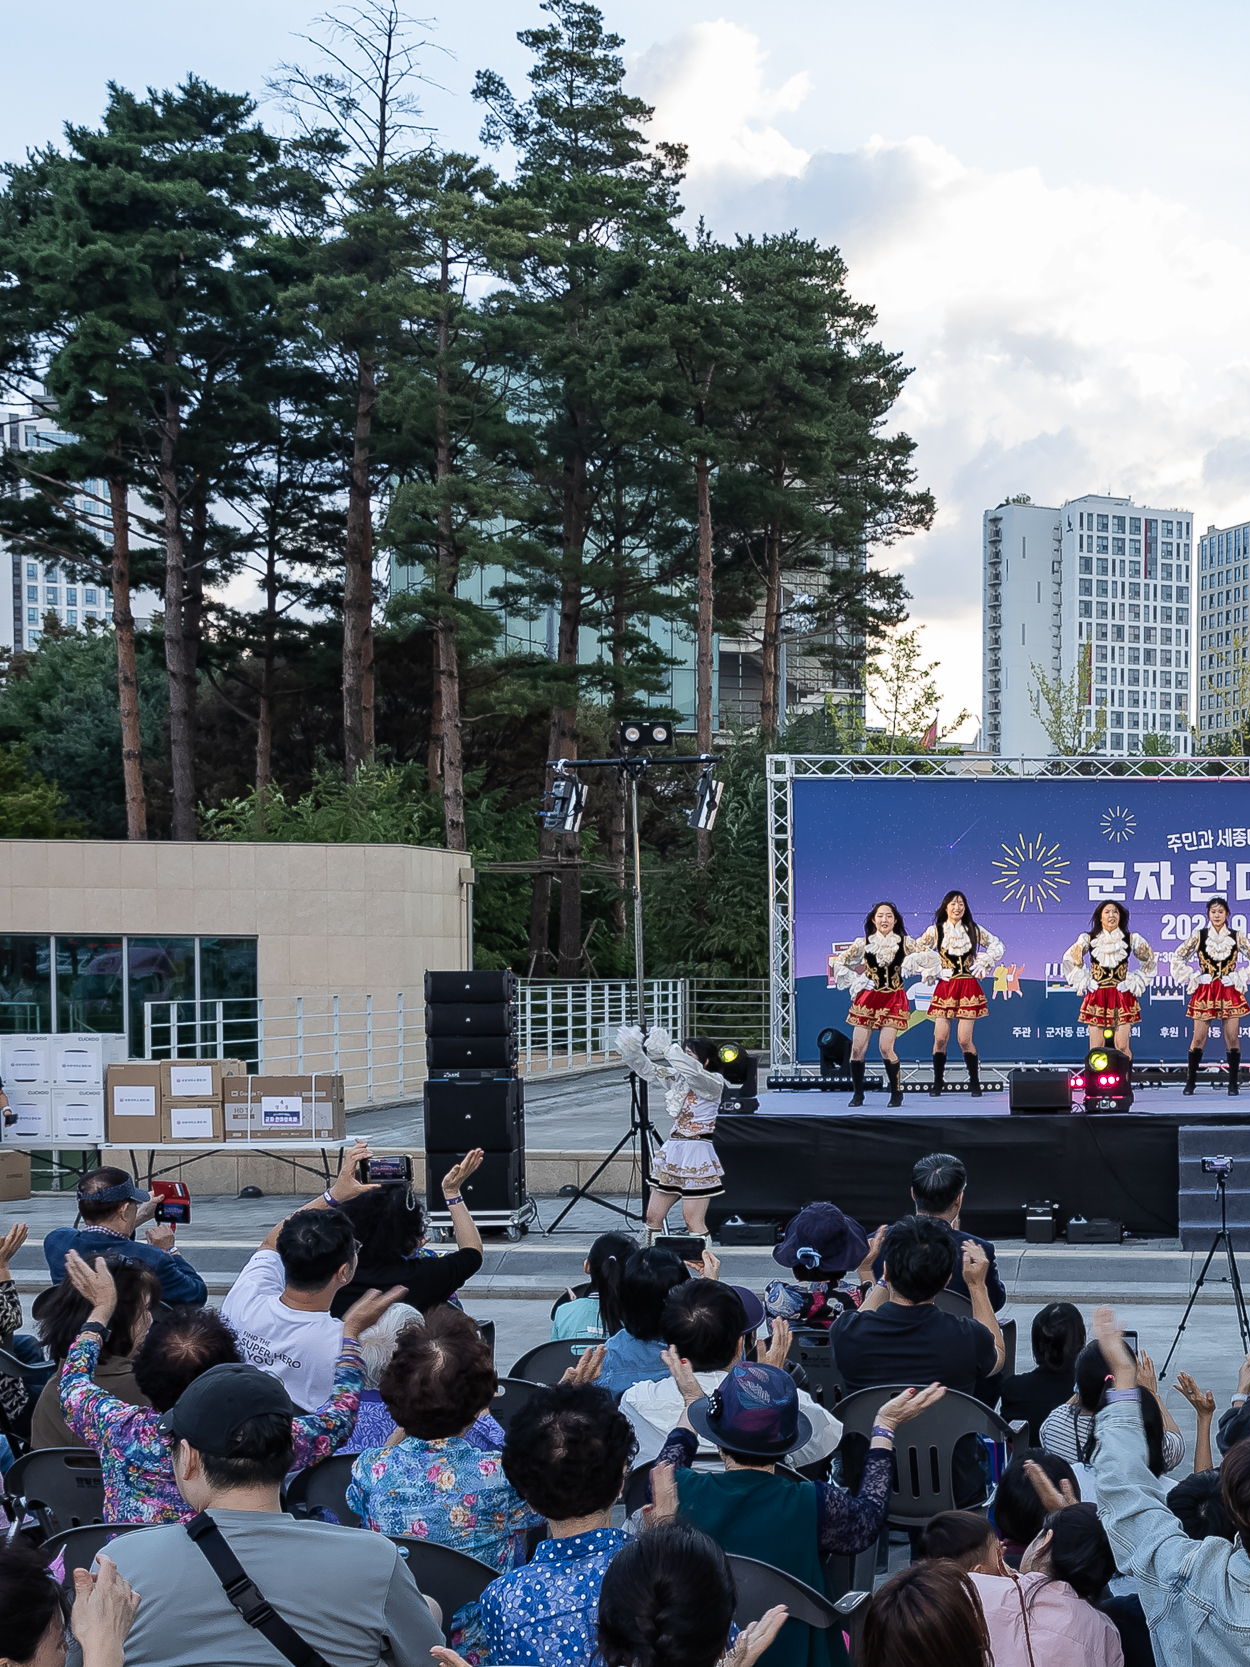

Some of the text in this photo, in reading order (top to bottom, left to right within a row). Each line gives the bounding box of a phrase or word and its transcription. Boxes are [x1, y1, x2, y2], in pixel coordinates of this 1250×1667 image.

[1166, 829, 1214, 854] 주민과
[1087, 861, 1175, 902] 군자
[1012, 1026, 1032, 1038] 주관
[1045, 1026, 1074, 1038] 군자동
[1159, 1026, 1179, 1038] 후원
[243, 1330, 271, 1348] FIND THE
[241, 1337, 301, 1369] SUPER HERO
[246, 1350, 274, 1367] YOU
